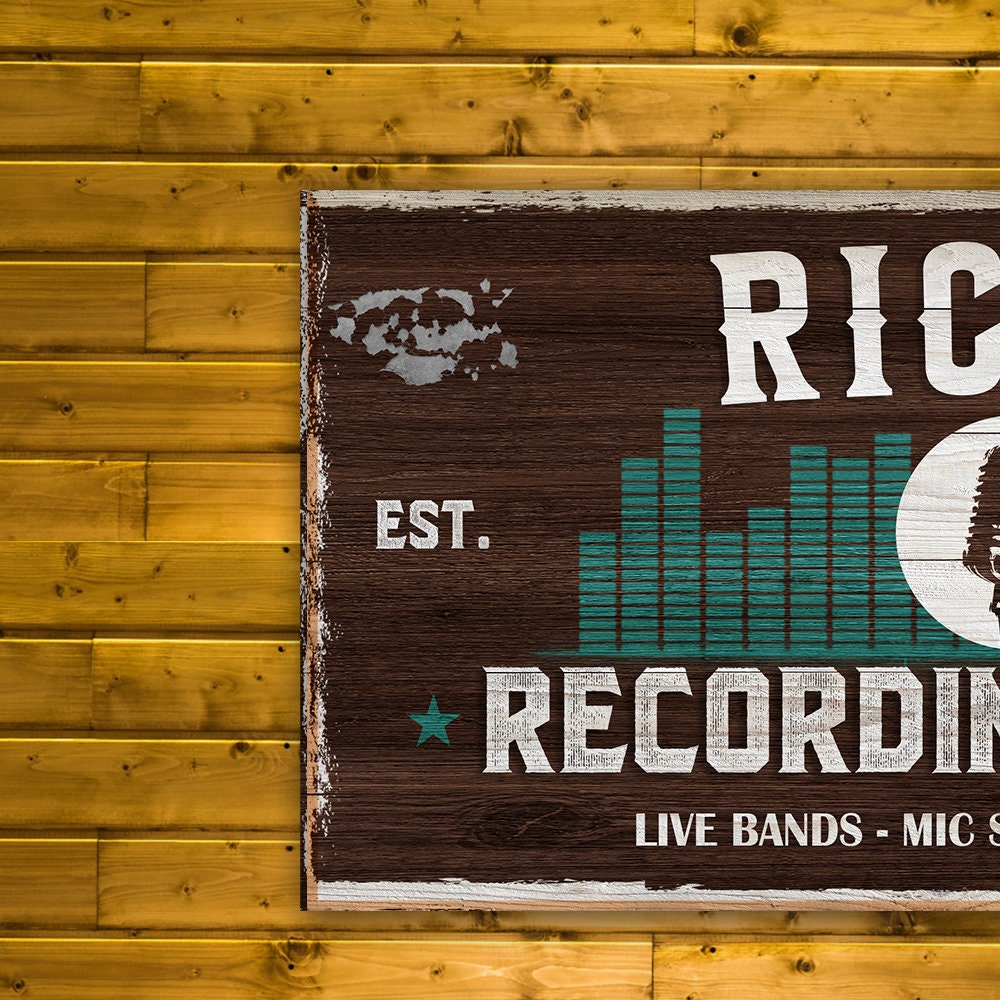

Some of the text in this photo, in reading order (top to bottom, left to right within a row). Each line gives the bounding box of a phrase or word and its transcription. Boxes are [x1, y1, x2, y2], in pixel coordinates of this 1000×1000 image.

[375, 499, 490, 551] EST.
[635, 812, 718, 847] LIVE
[732, 812, 863, 847] BANDS
[903, 812, 975, 847] MIC
